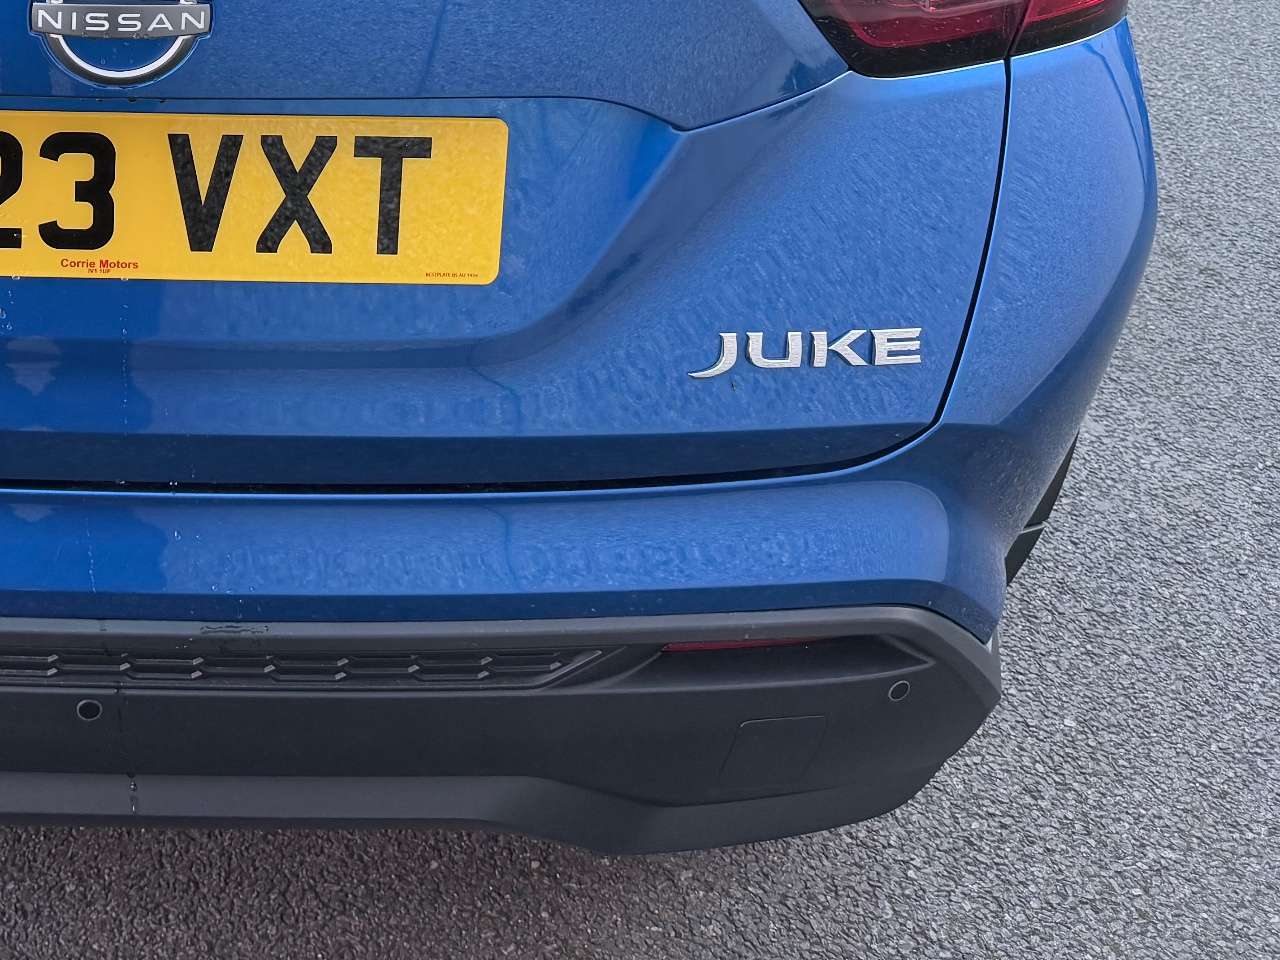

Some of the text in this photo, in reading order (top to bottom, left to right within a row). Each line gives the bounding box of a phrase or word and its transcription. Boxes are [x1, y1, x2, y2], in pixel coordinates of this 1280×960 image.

[37, 9, 205, 32] NISSAN
[167, 133, 433, 255] VXT
[60, 258, 139, 269] Corrie Motors
[687, 327, 922, 378] JUKE
